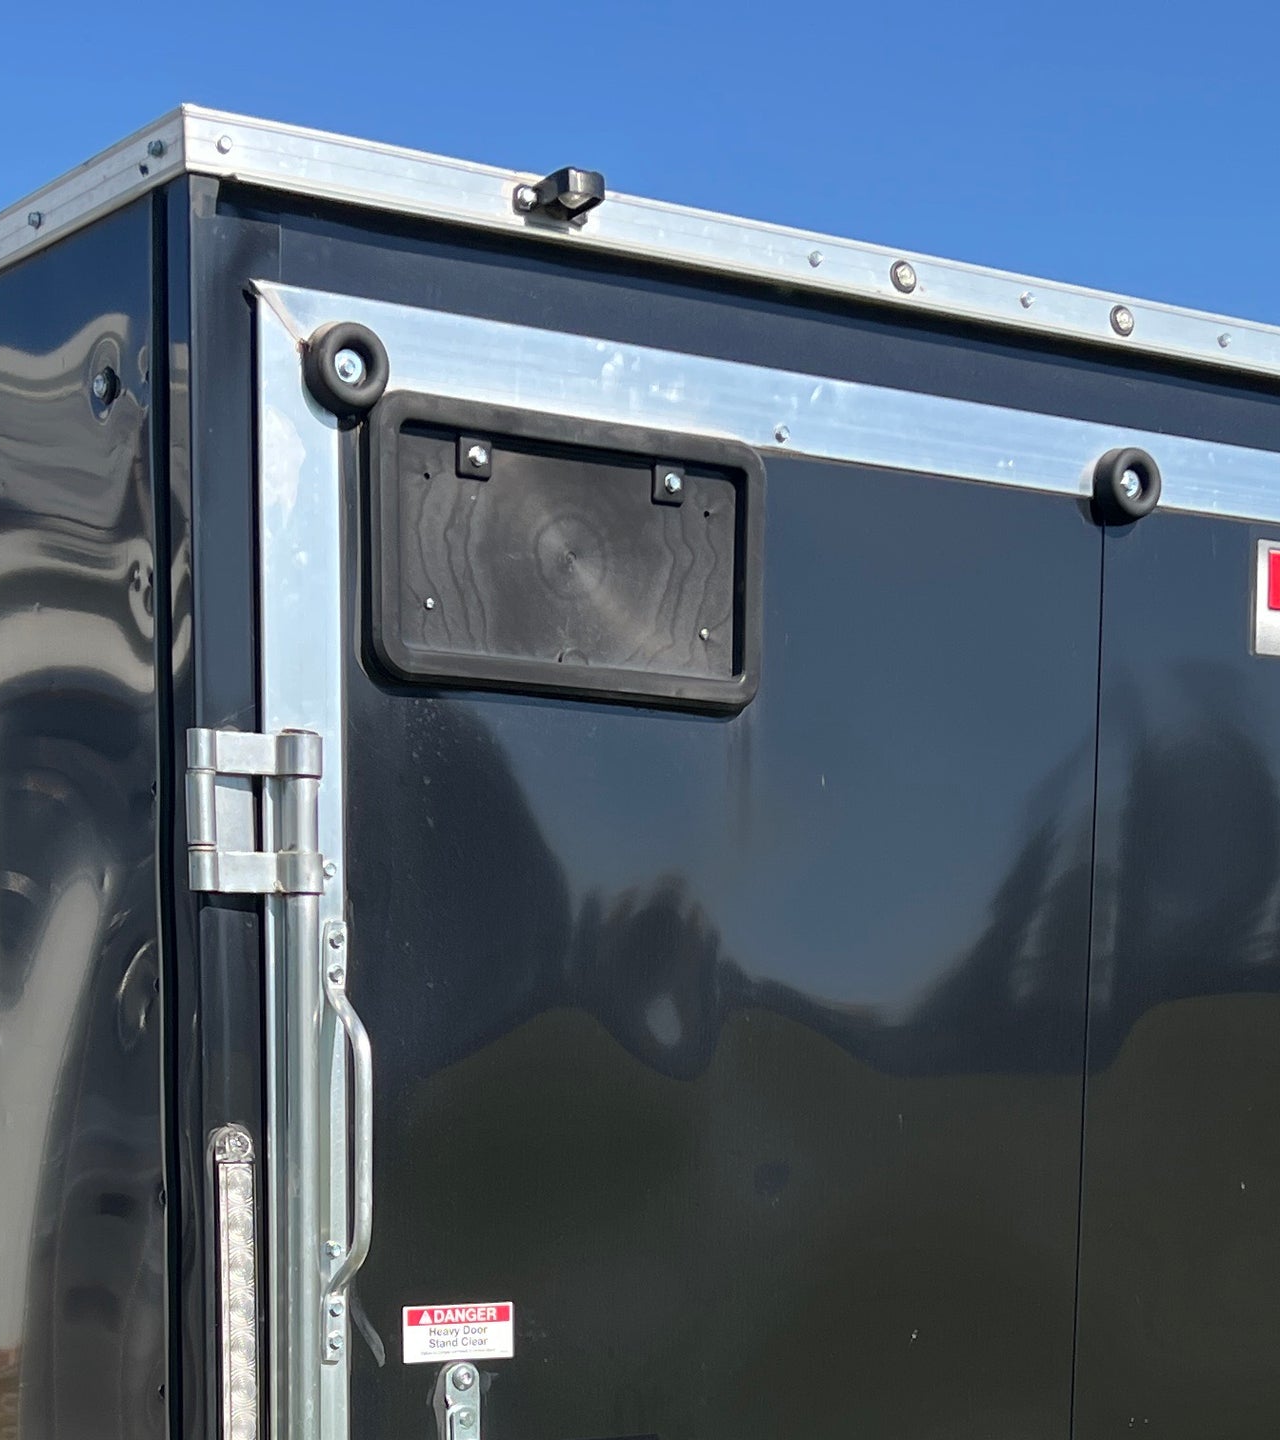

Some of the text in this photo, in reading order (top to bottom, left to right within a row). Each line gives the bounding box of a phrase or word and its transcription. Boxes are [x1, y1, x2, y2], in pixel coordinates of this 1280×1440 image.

[434, 1307, 497, 1323] DANGER
[429, 1325, 488, 1337] Heavy Door
[429, 1336, 488, 1348] Stand Clear
